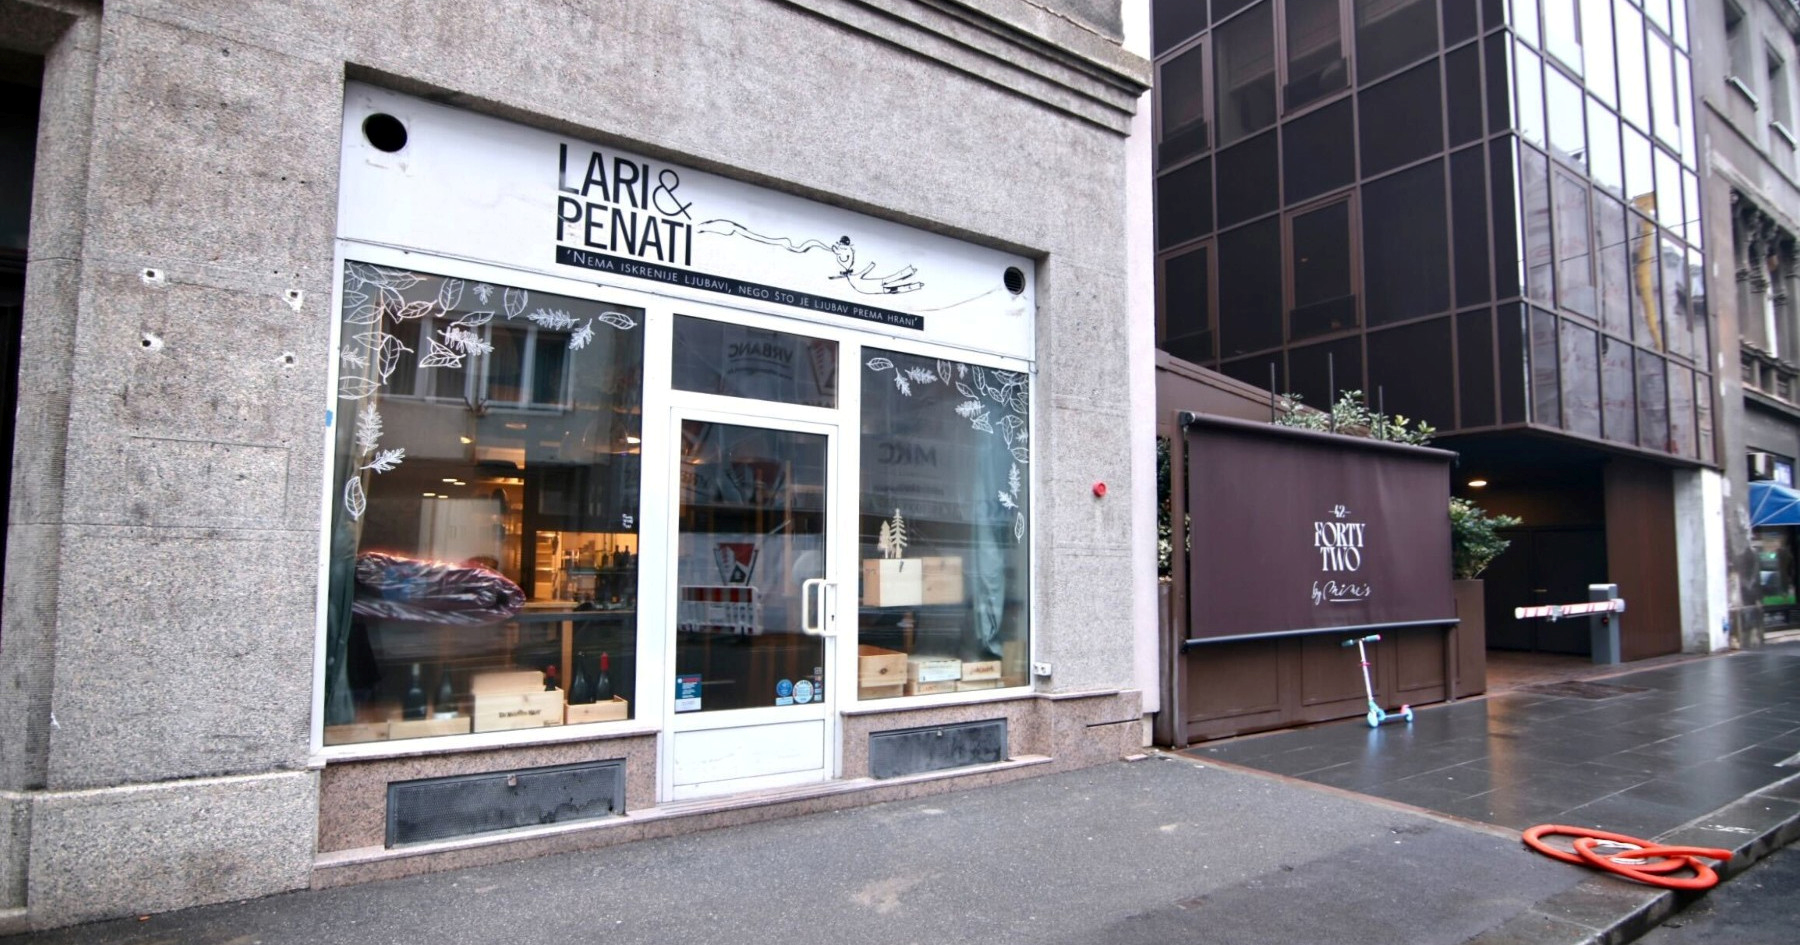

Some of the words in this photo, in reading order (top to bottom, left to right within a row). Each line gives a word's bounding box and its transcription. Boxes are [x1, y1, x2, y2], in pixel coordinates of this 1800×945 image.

[556, 195, 693, 267] PENATI
[684, 274, 732, 294] LJUBAVI,
[738, 285, 770, 299] NEGO
[774, 291, 795, 304] ŠTO
[799, 297, 810, 307] JE
[814, 298, 849, 314] LJUBAV
[853, 307, 884, 321] PREMA
[1314, 521, 1366, 547] FORTY
[1320, 546, 1361, 572] TWO
